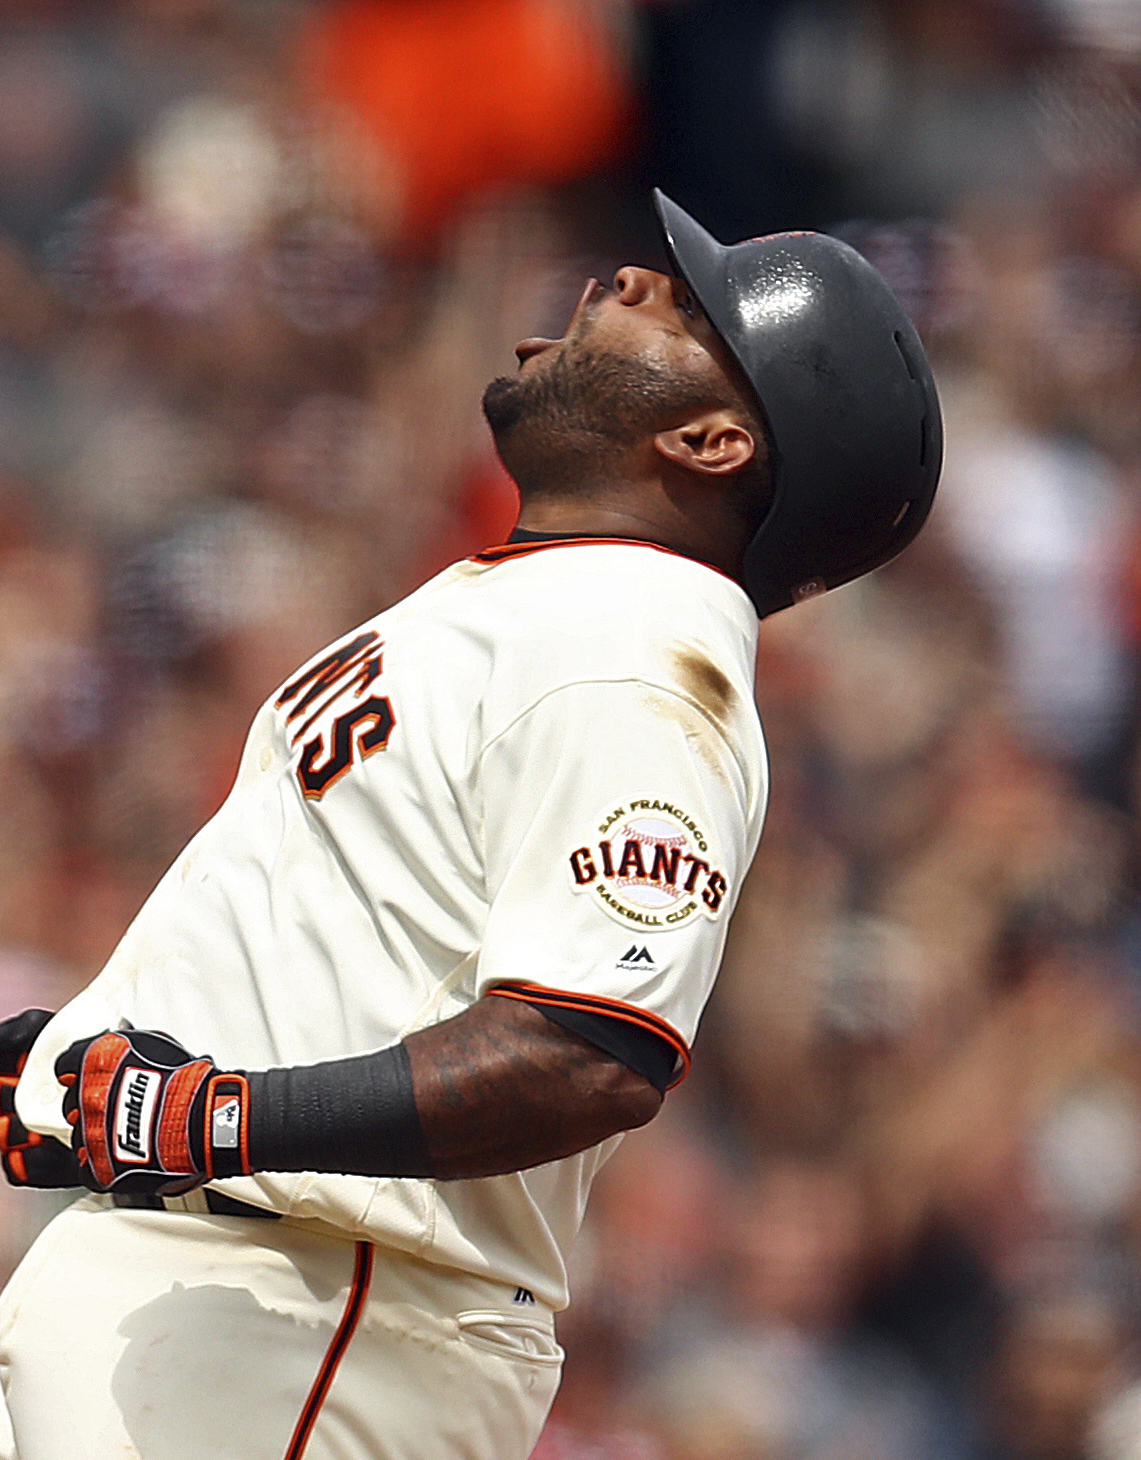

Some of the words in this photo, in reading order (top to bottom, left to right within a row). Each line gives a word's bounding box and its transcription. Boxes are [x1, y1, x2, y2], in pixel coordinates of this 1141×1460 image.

[599, 807, 625, 834] SAN
[629, 799, 708, 853] FRANCISCO
[569, 838, 727, 912] GIANTS
[596, 884, 664, 927] BASEBALL
[665, 901, 698, 924] CLUB
